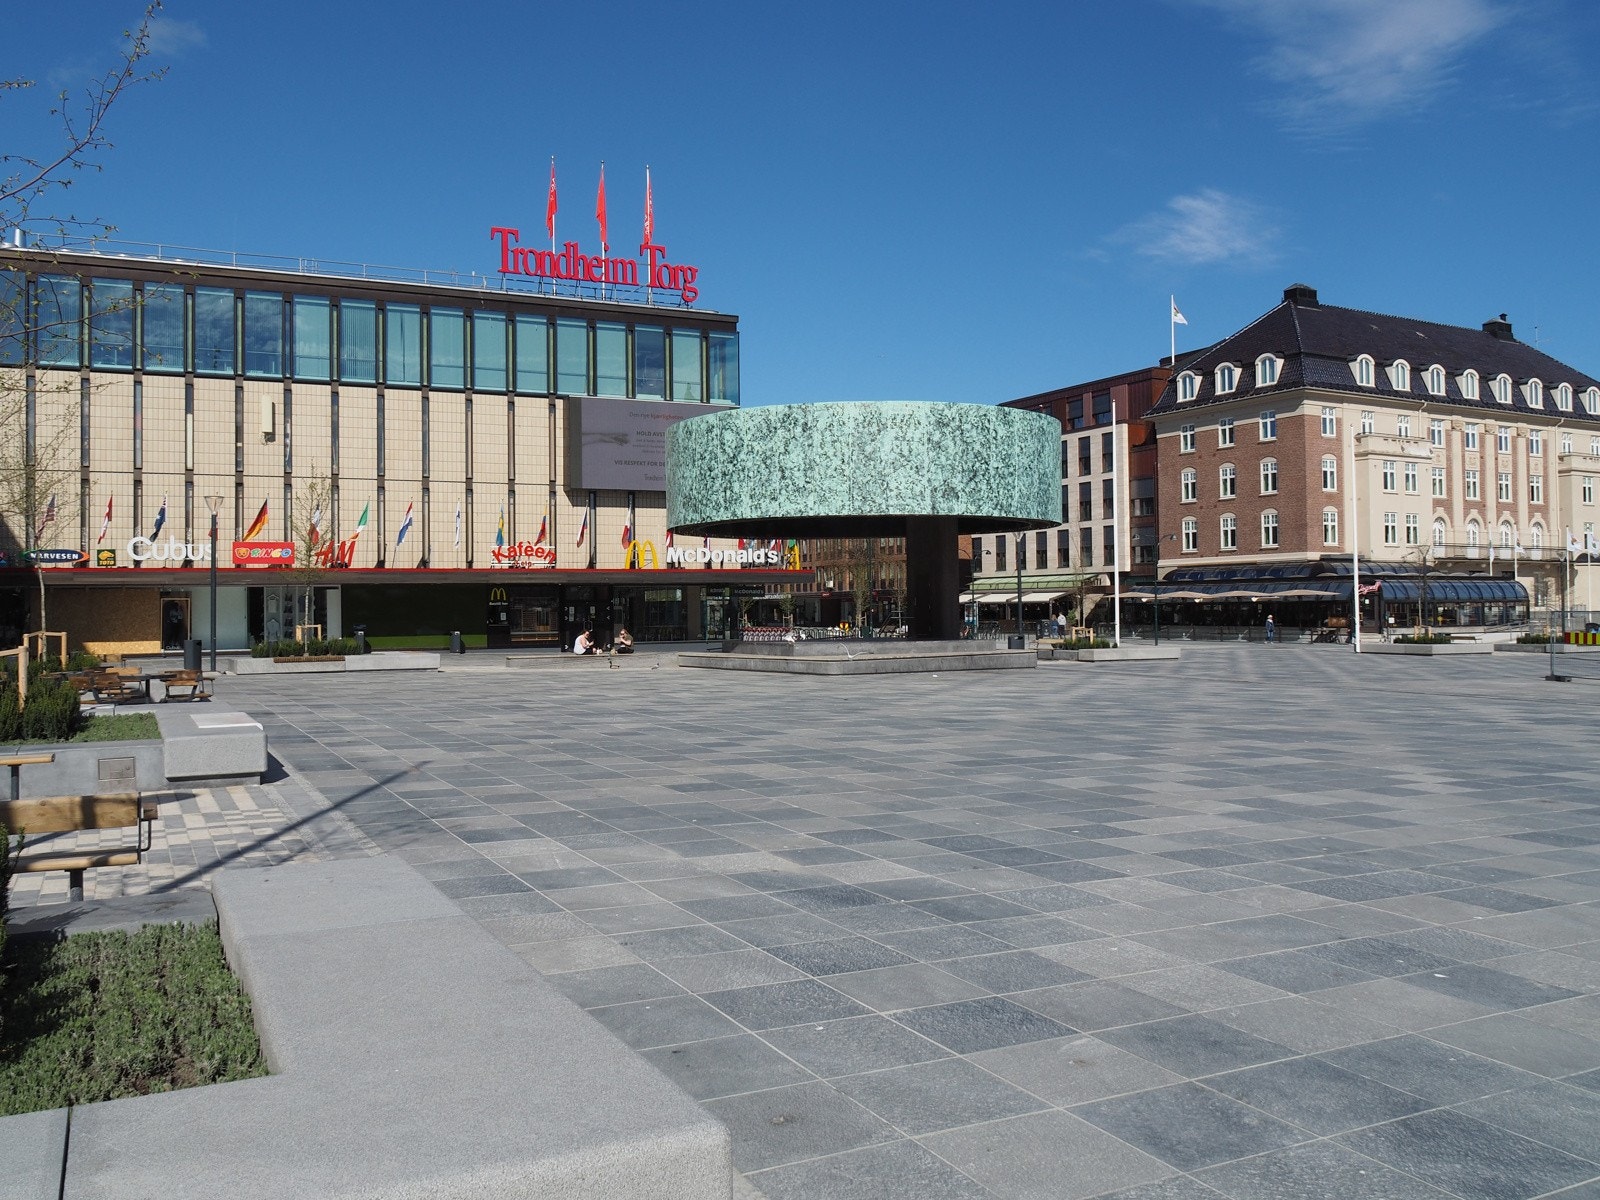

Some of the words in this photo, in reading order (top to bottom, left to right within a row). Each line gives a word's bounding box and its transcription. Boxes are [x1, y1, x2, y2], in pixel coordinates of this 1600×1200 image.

[491, 227, 639, 286] Trondheim
[640, 243, 699, 302] Torg
[251, 548, 292, 558] RINGO
[666, 547, 779, 563] McDonald's
